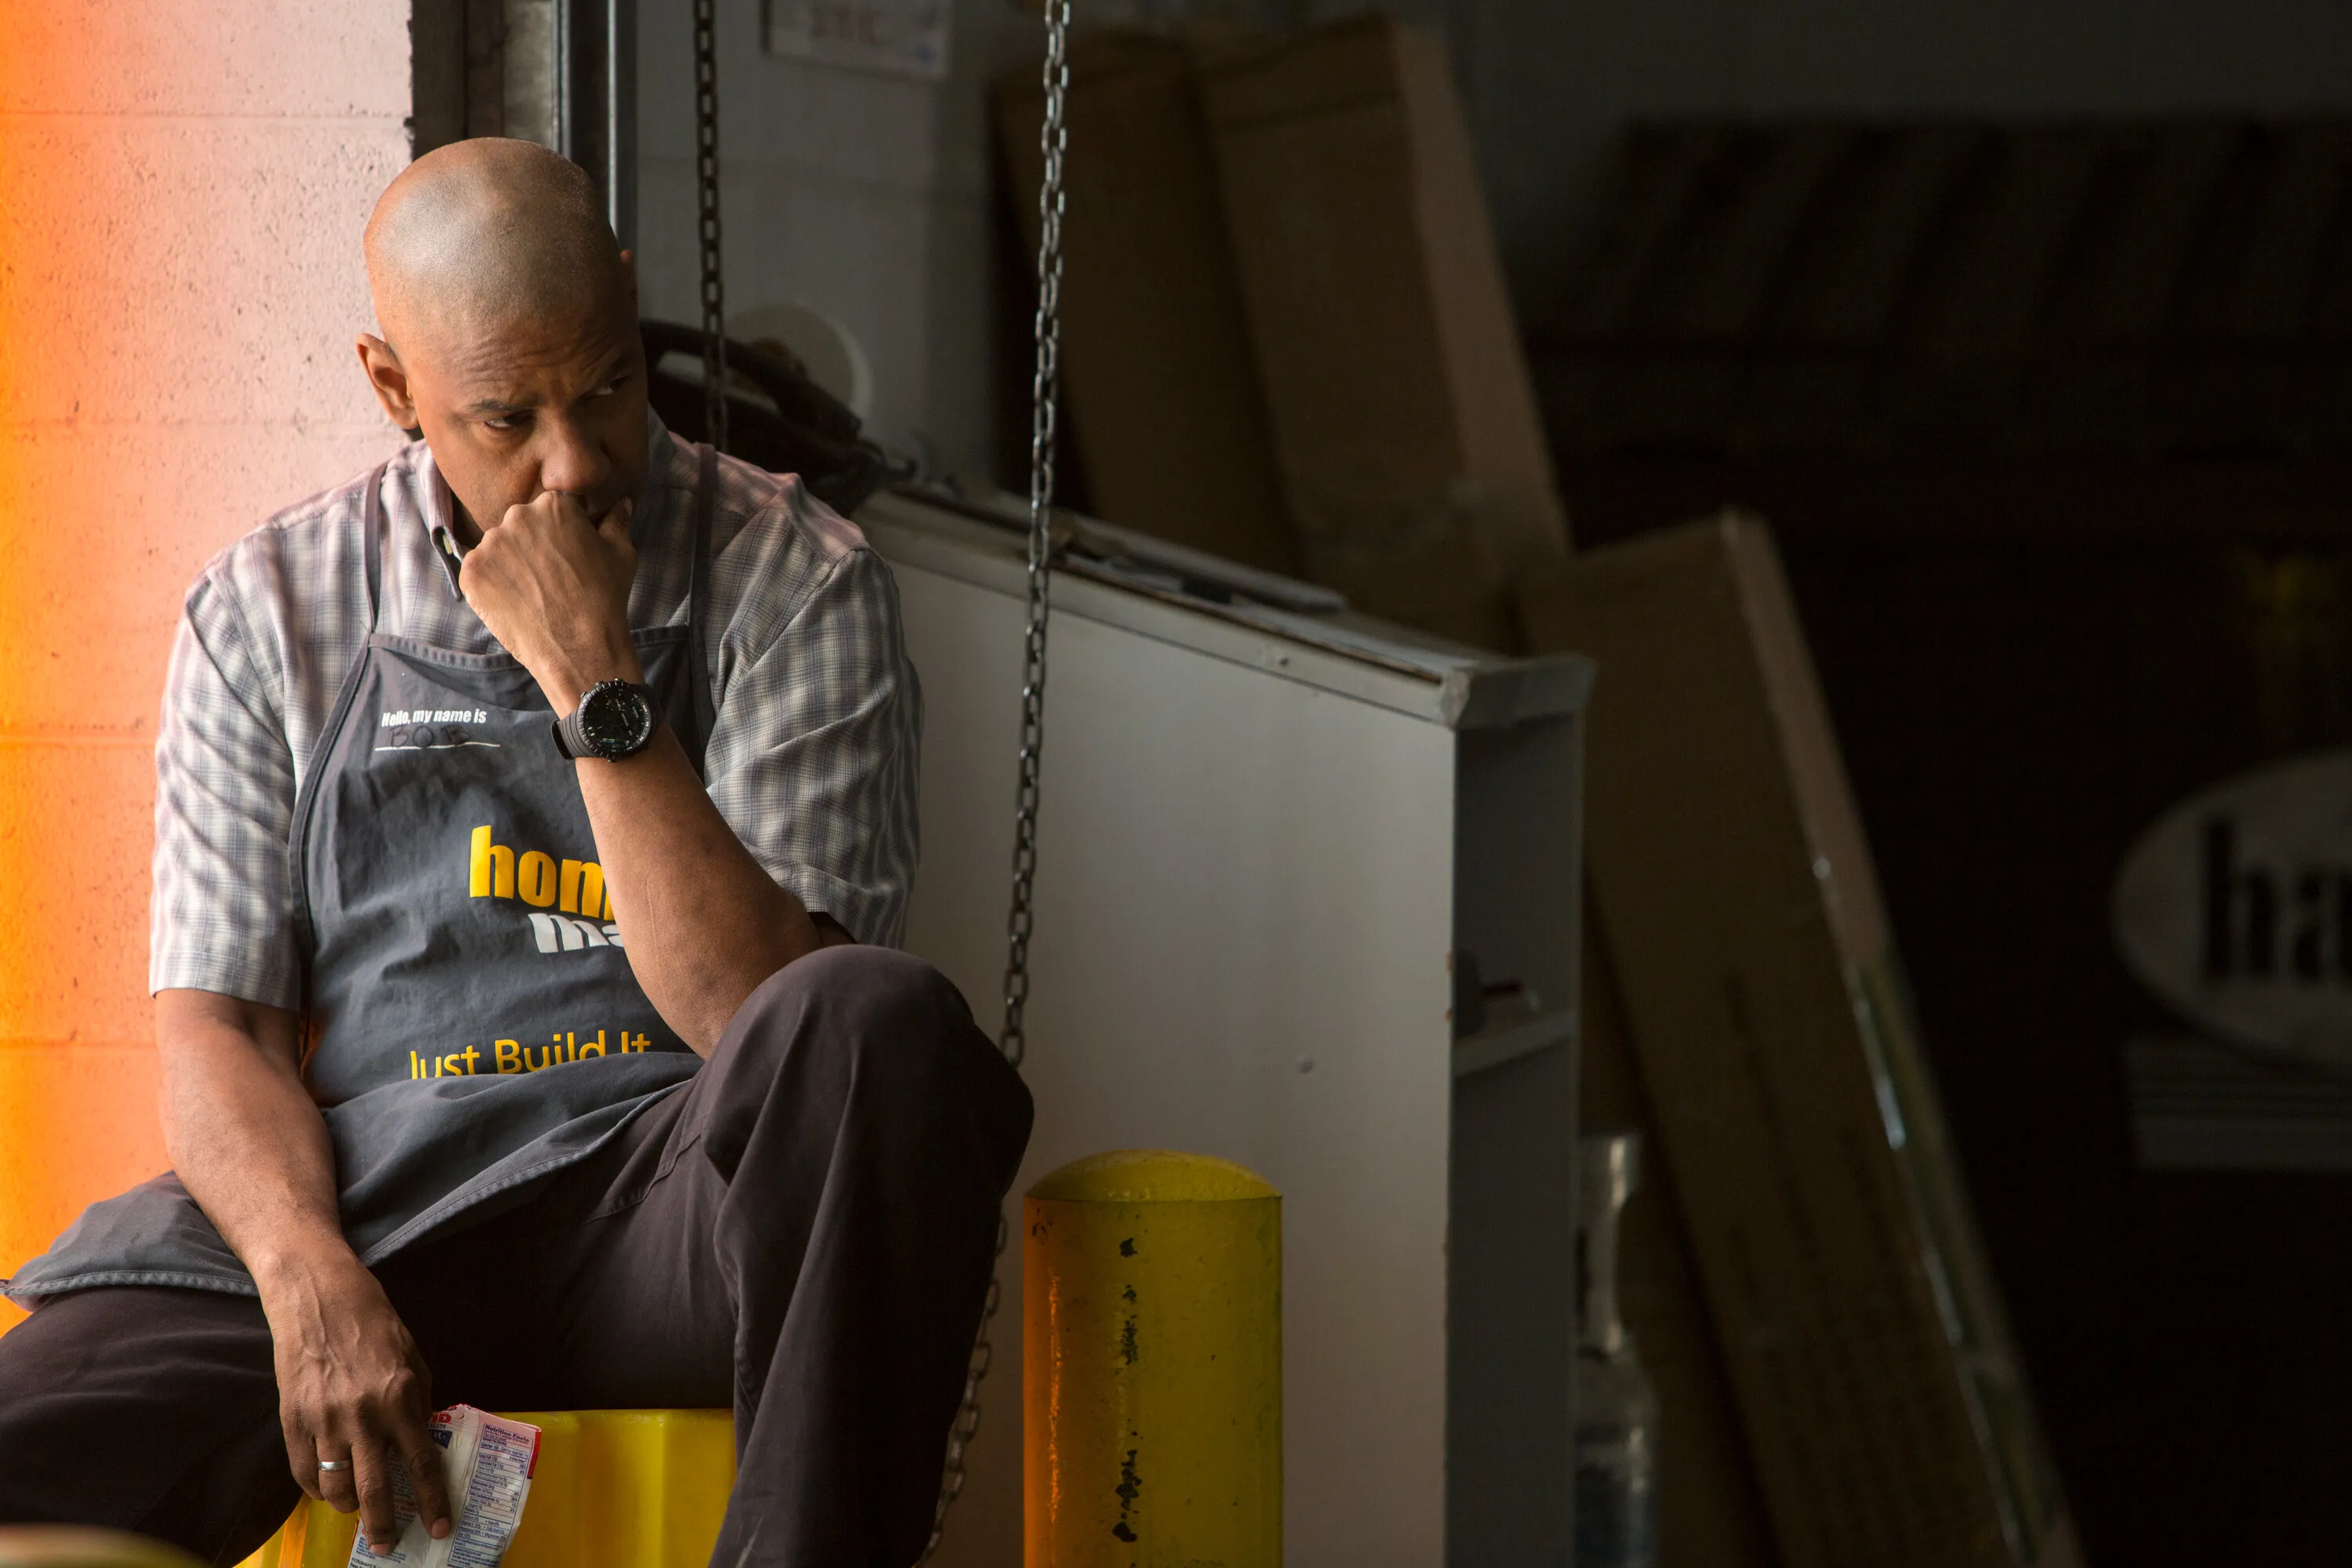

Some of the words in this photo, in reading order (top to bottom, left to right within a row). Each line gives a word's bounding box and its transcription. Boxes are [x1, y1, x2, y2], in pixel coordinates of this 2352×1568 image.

[381, 710, 411, 727] Hello,
[412, 710, 433, 724] my
[433, 710, 472, 723] name
[473, 708, 488, 724] is
[495, 1029, 606, 1074] Build
[621, 1031, 651, 1053] It
[485, 1425, 512, 1436] Nutrition
[513, 1433, 529, 1442] Facts
